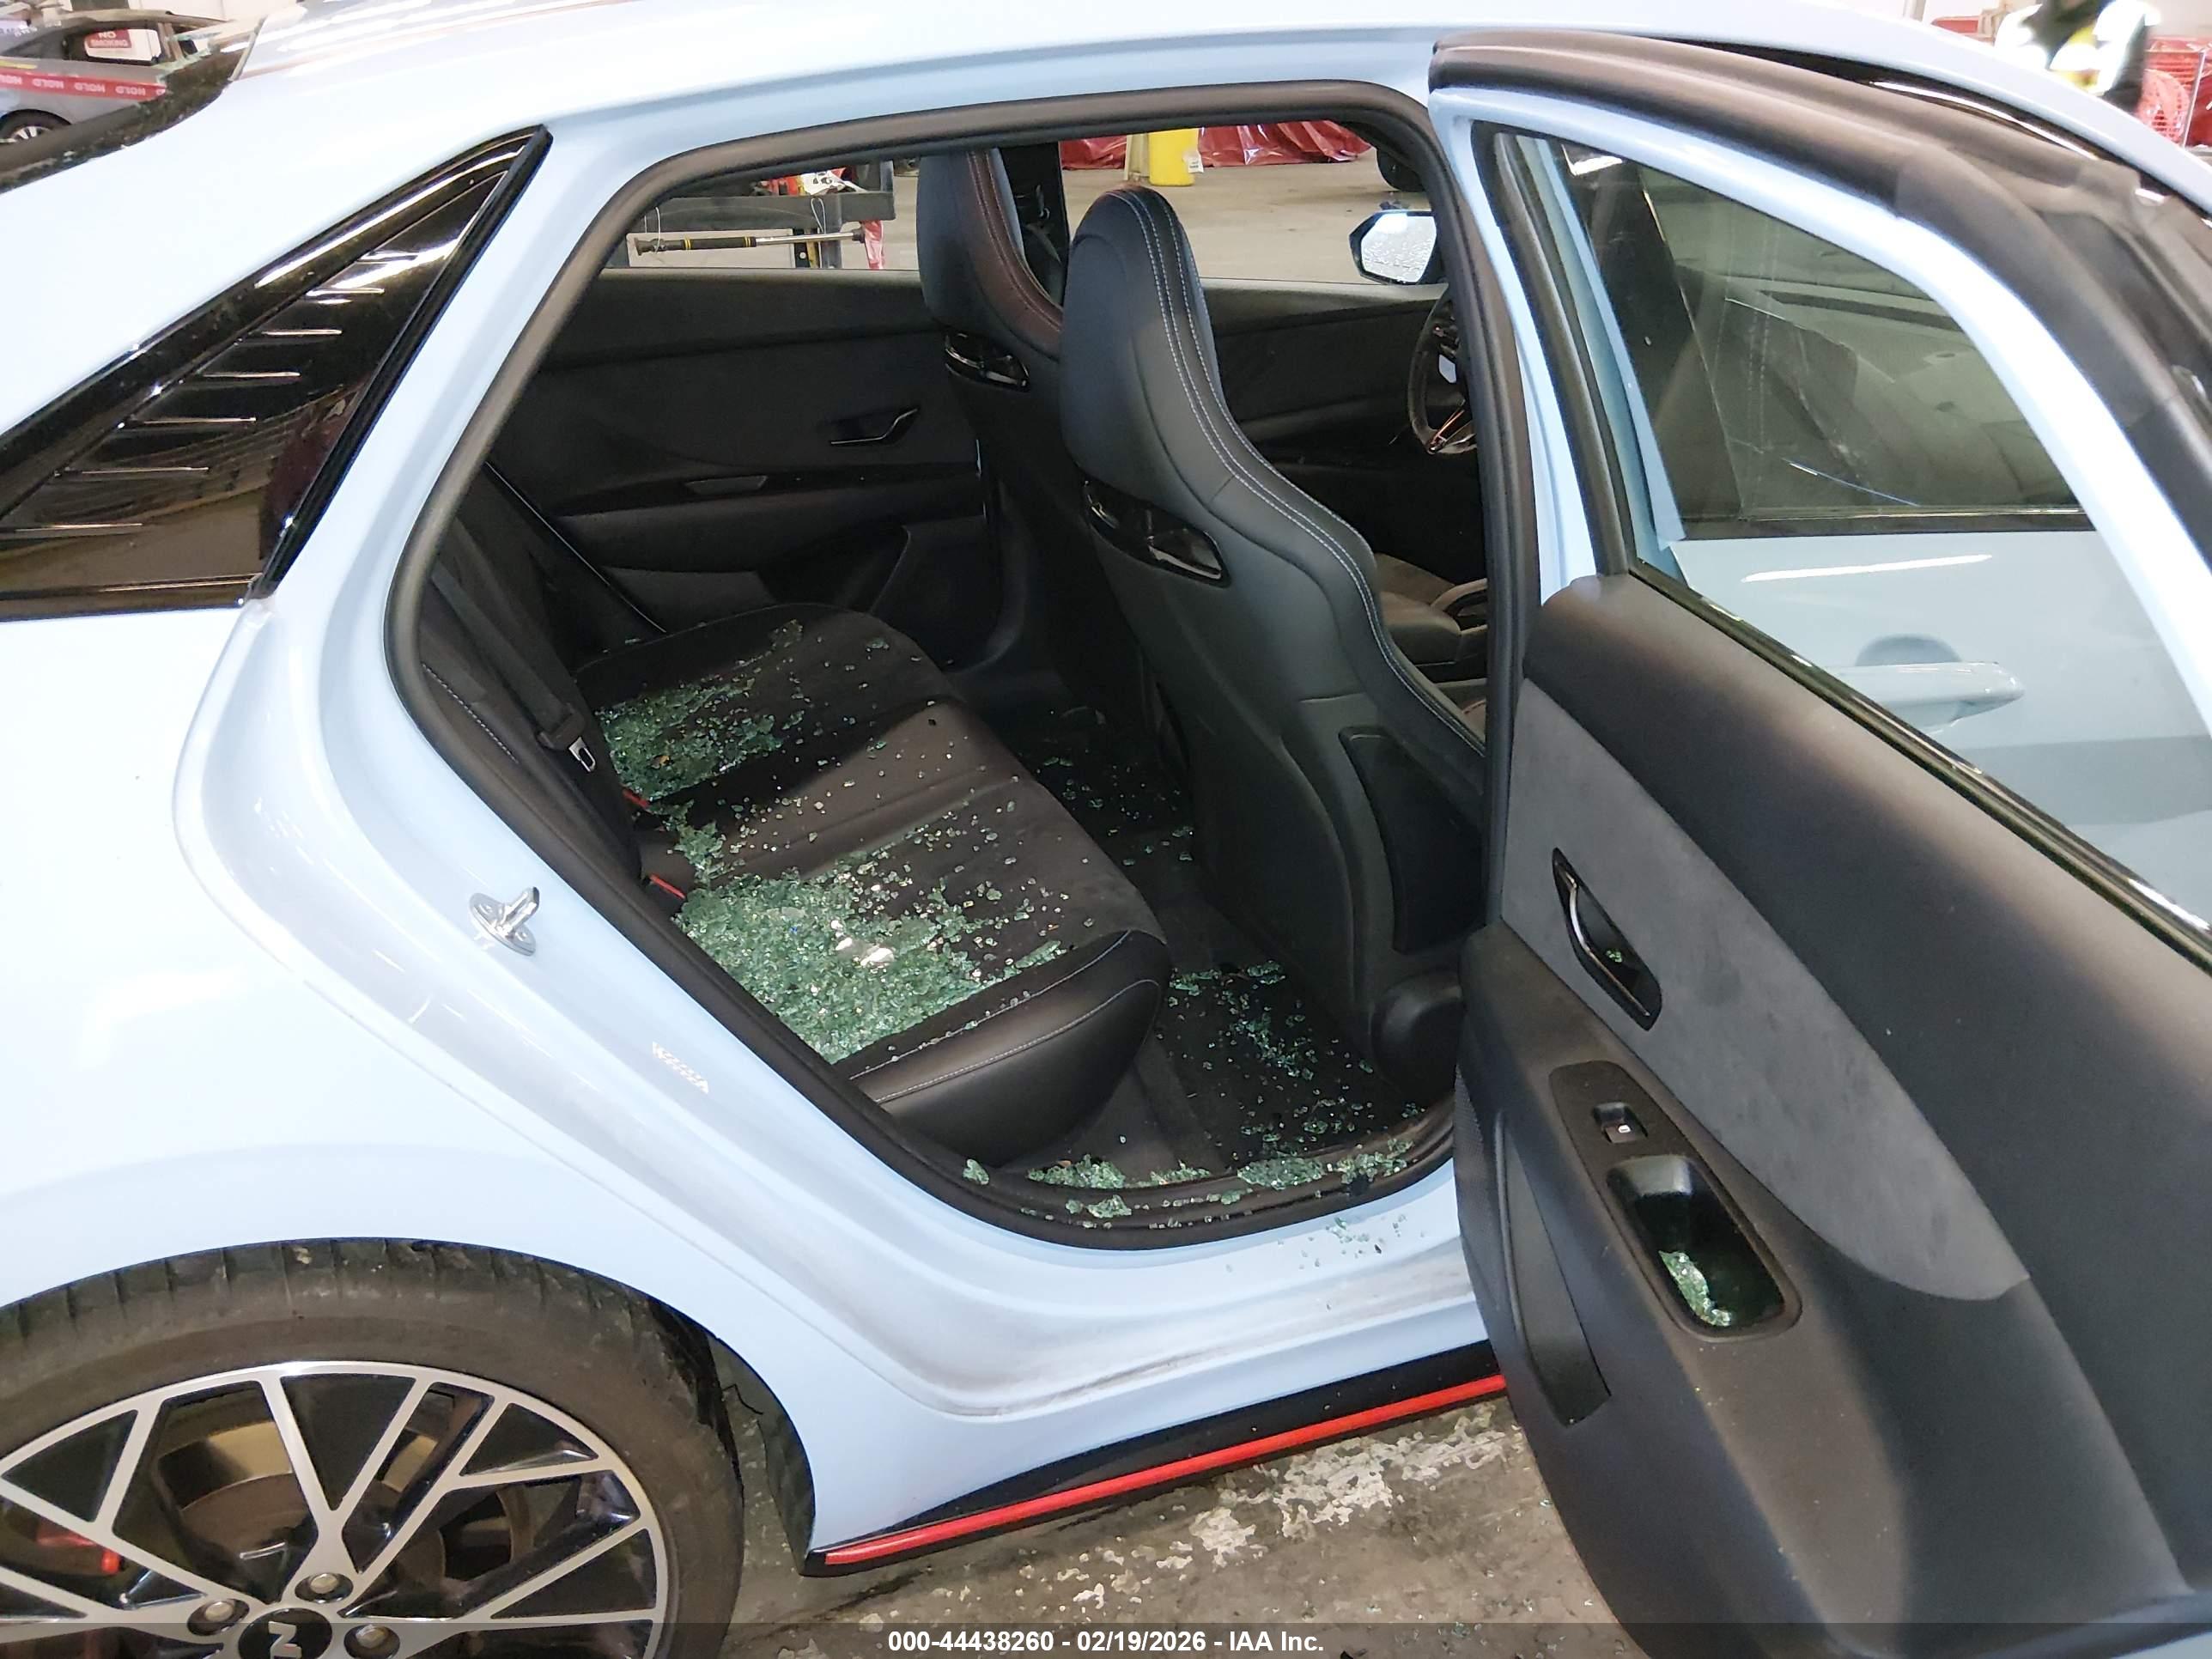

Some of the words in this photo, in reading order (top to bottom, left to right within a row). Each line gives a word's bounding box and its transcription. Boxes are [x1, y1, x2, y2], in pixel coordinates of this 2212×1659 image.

[32, 78, 64, 88] HOLD
[74, 82, 106, 93] HOLD
[116, 85, 146, 95] HOLD
